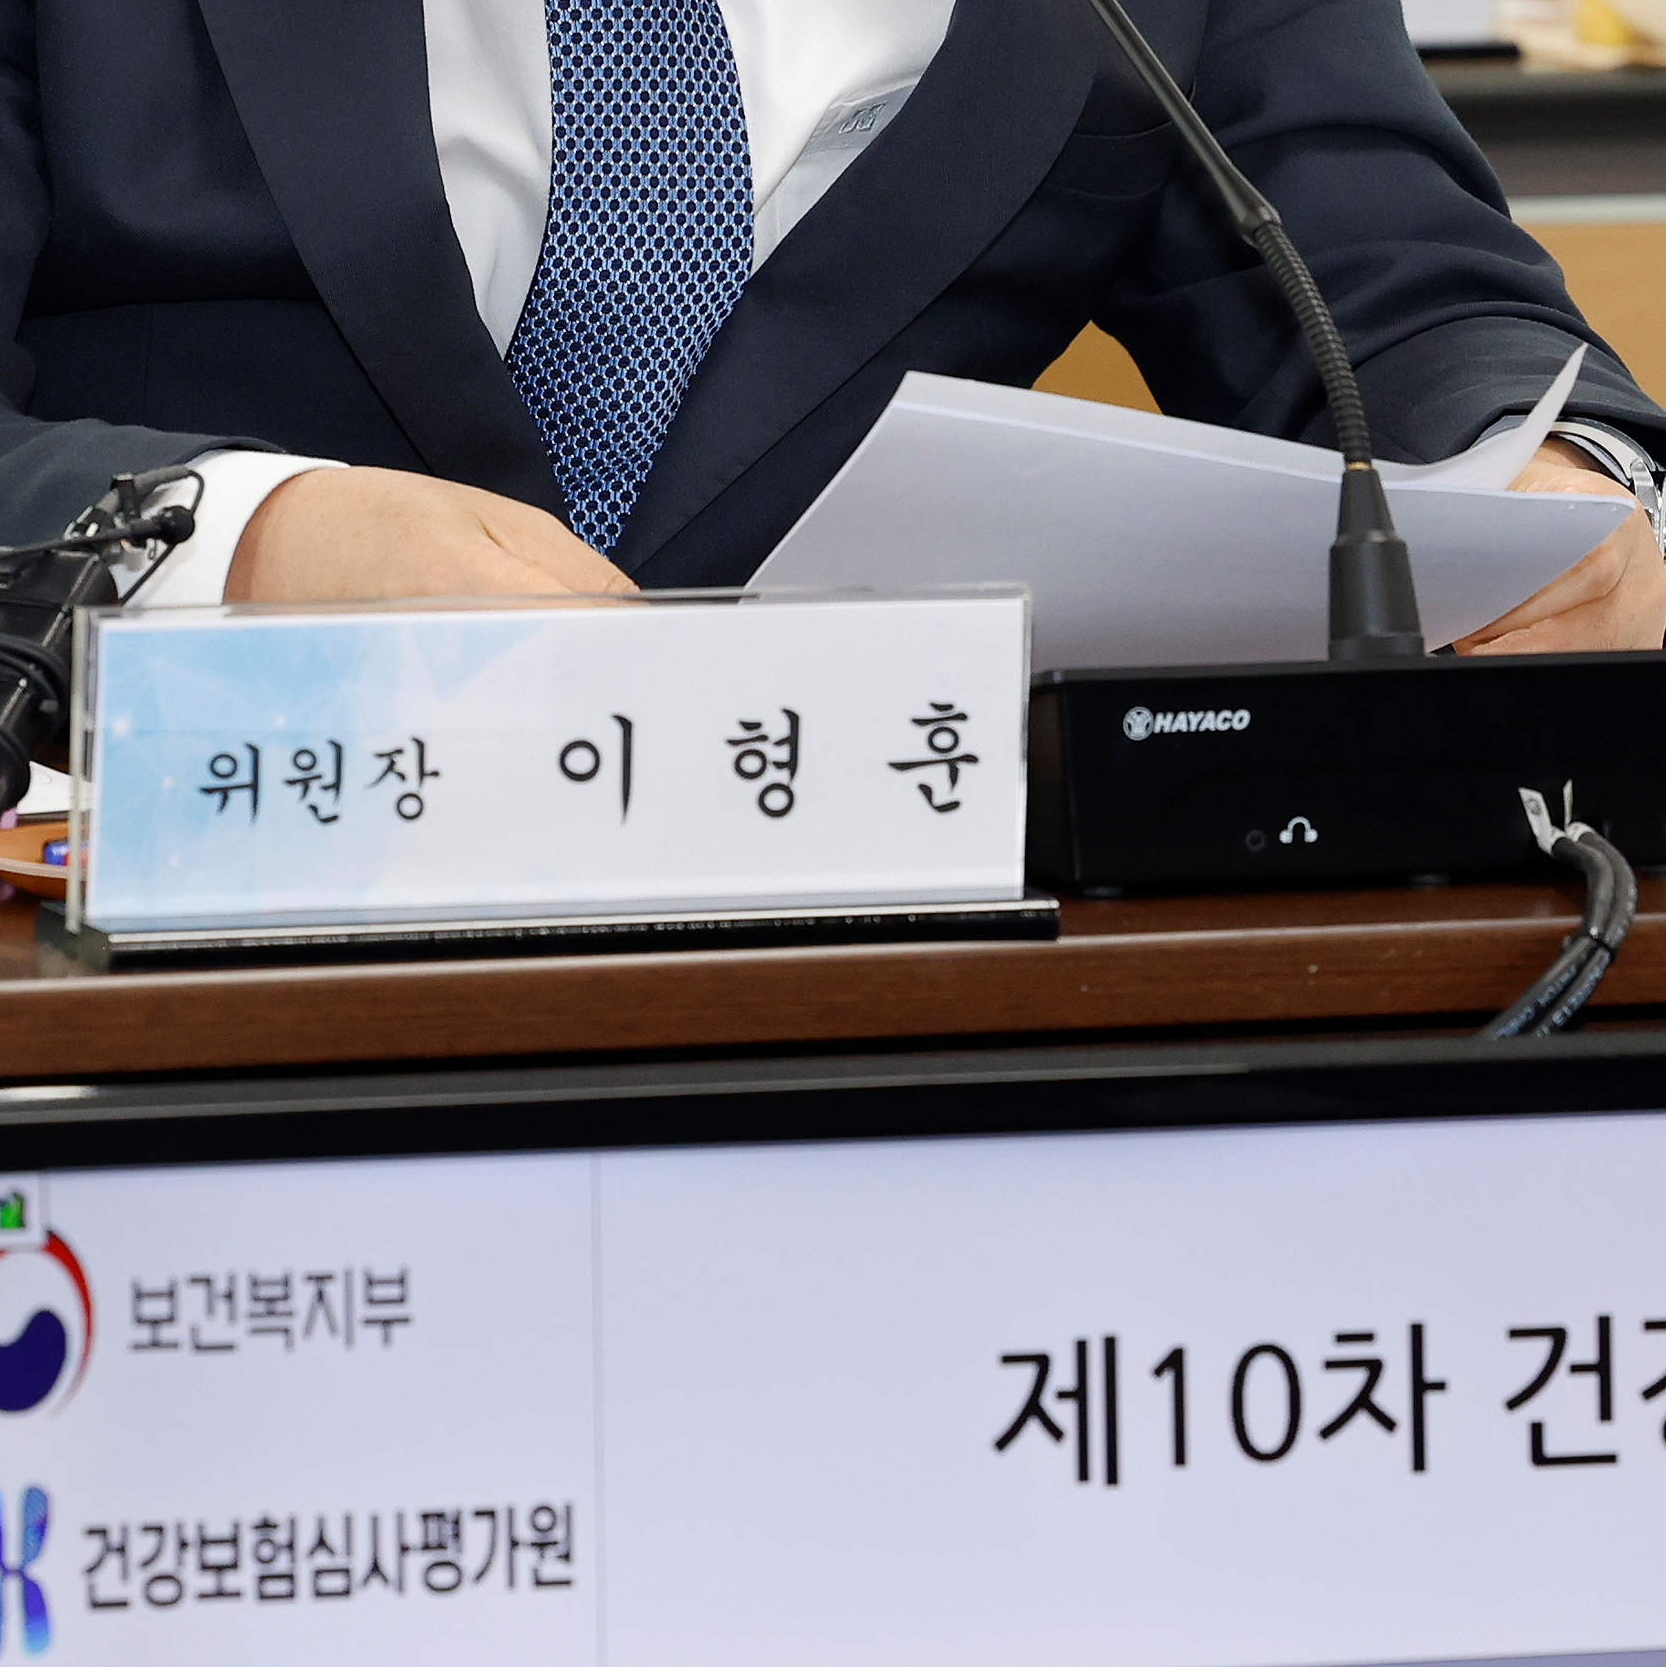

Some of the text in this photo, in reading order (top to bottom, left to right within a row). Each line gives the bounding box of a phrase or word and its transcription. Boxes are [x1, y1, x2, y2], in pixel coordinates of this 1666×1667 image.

[1153, 708, 1251, 734] HAYACO
[199, 737, 440, 825] 위원장
[131, 1269, 412, 1353] 보건복지부
[993, 1323, 1447, 1487] 제10차
[83, 1503, 574, 1610] 건강보험심사평가원
